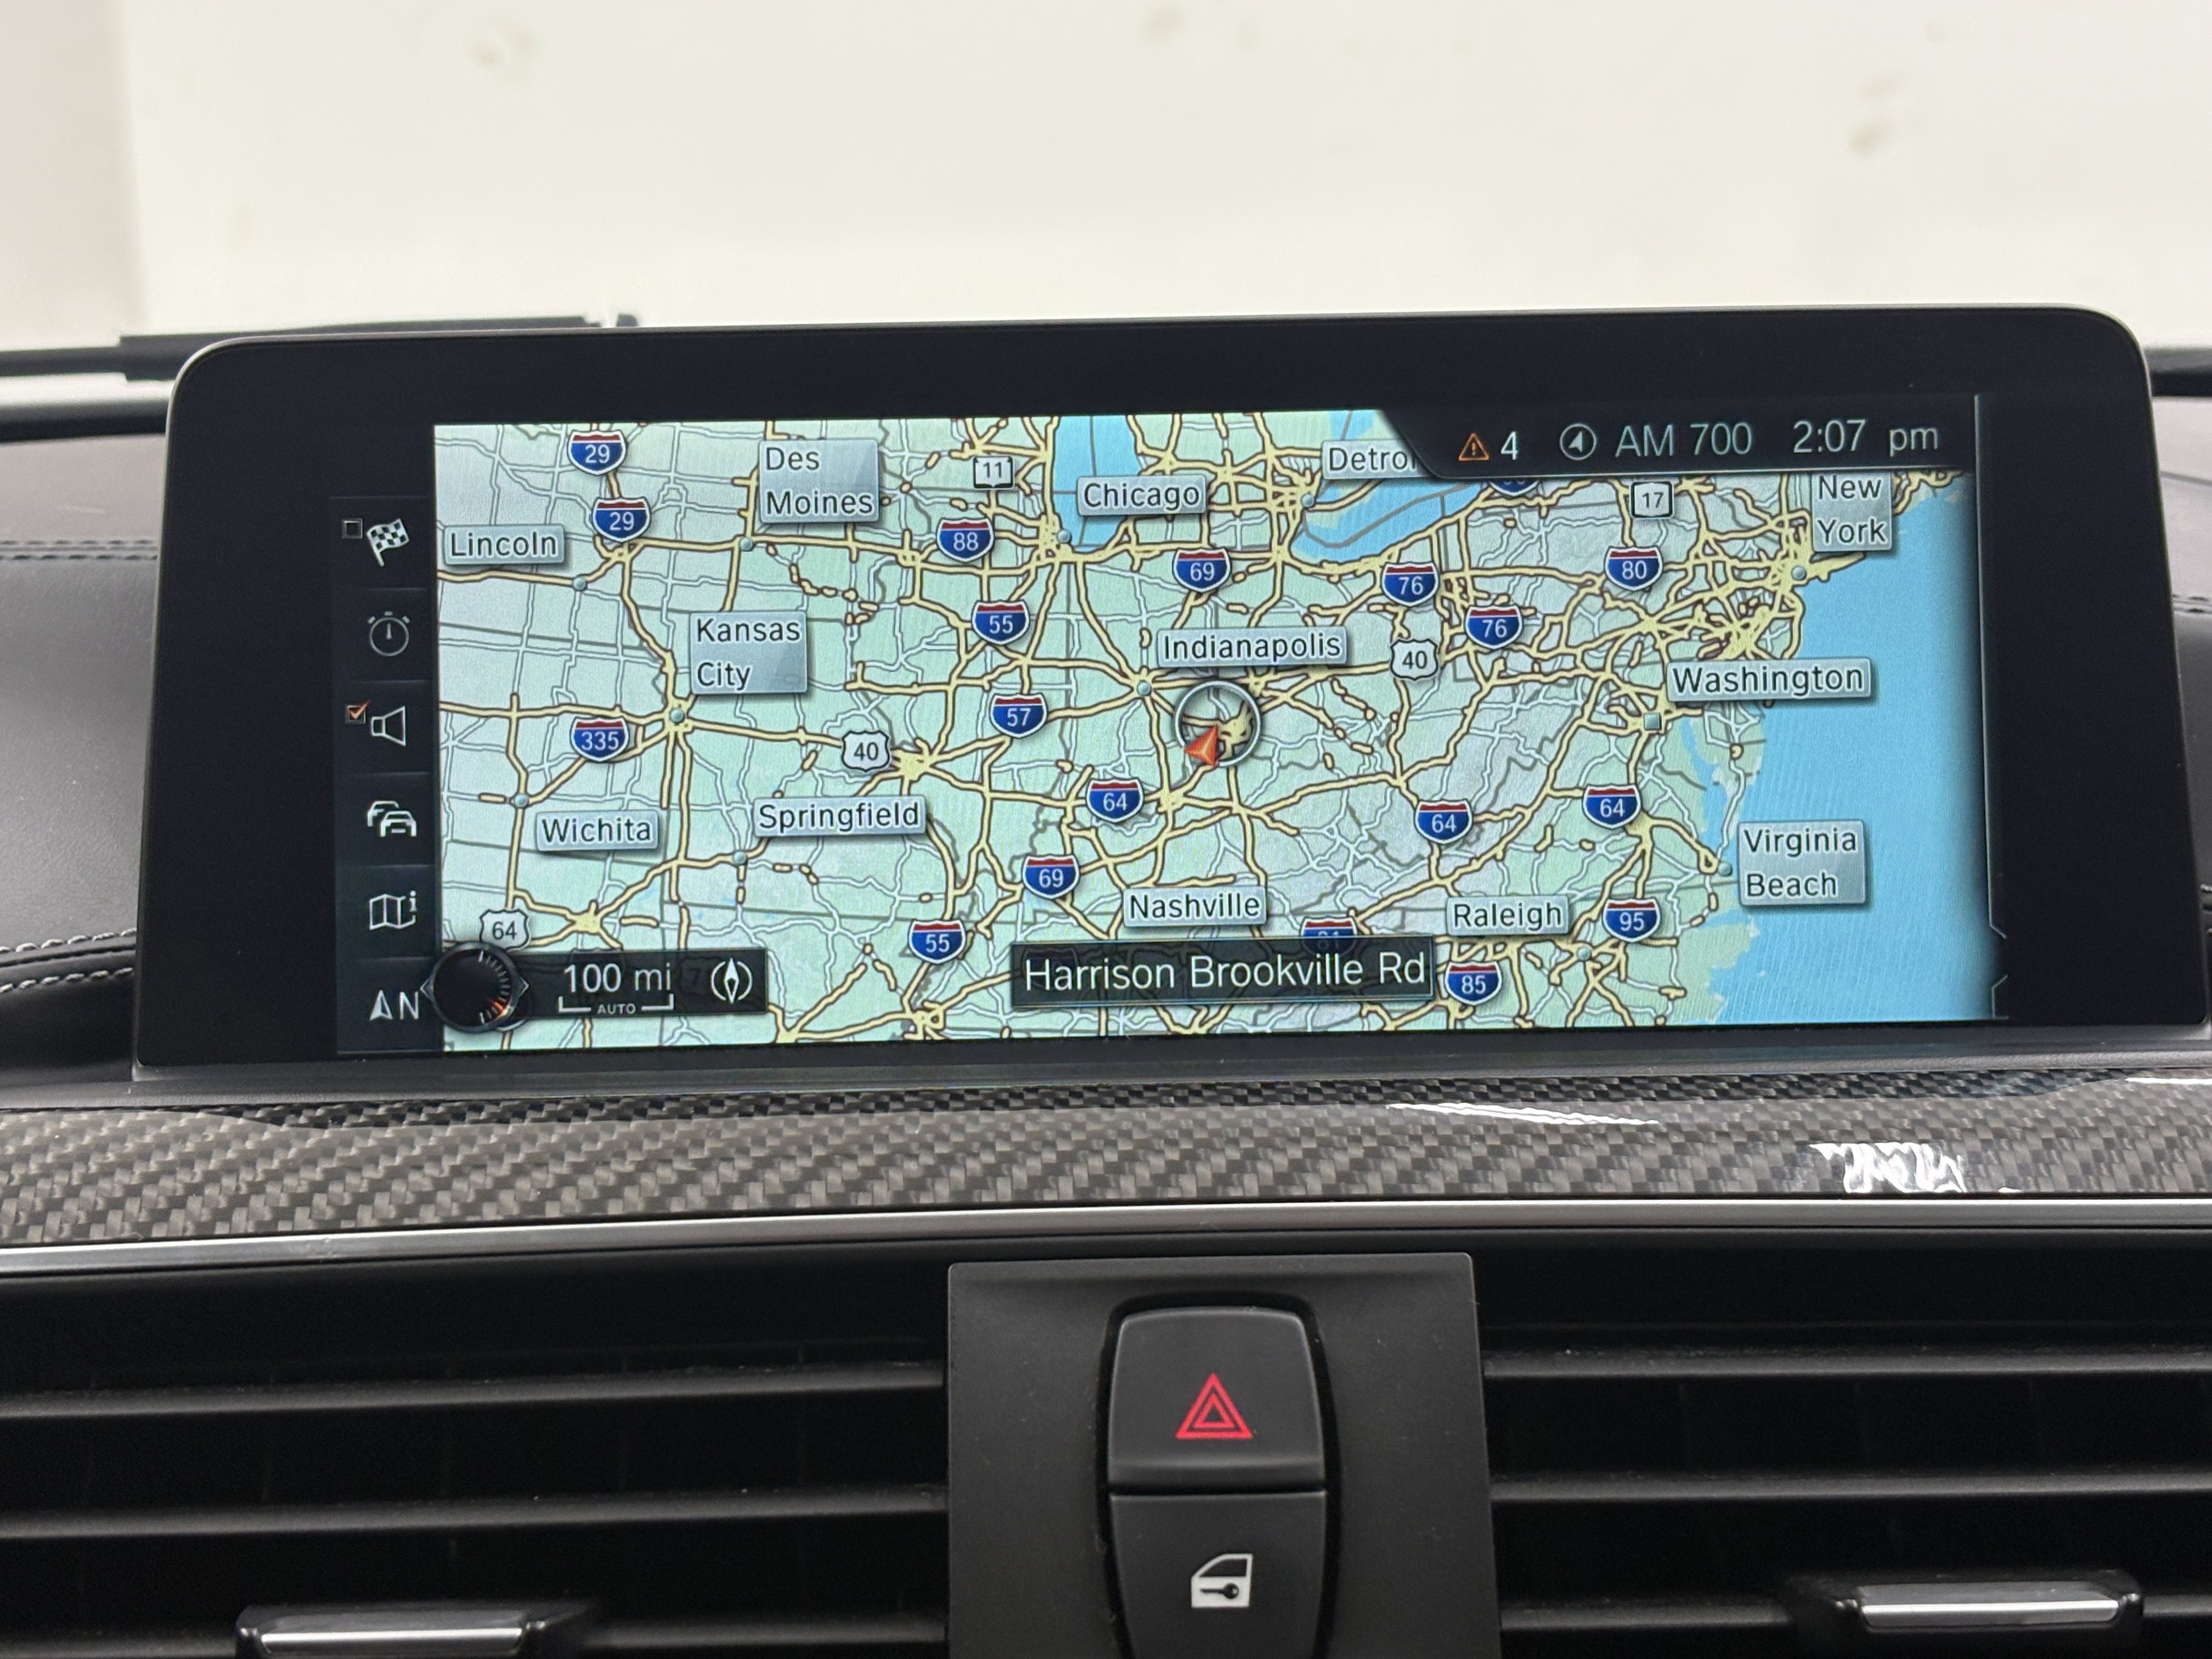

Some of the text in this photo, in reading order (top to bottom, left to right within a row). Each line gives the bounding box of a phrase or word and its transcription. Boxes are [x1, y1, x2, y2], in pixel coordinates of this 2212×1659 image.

[1500, 431, 1518, 460] 4
[1616, 422, 1752, 458] AM 700
[1793, 420, 1938, 456] 2:07 pm
[585, 444, 610, 464] 29
[766, 447, 820, 471] Des
[984, 461, 1002, 478] 11
[1084, 483, 1200, 510] Chicago
[1819, 476, 1882, 500] New
[766, 490, 873, 516] Moines
[1642, 492, 1663, 509] 17
[610, 511, 635, 531] 29
[1817, 518, 1887, 544] York
[450, 532, 557, 557] Lincoln
[953, 532, 978, 551] 88
[1190, 562, 1215, 582] 69
[1622, 560, 1646, 580] 80
[1398, 577, 1423, 596] 76
[696, 619, 800, 642] Kansas
[989, 615, 1013, 634] 55
[1482, 619, 1507, 638] 76
[1164, 631, 1341, 662] Indianapolis
[1402, 651, 1426, 670] 40
[697, 661, 751, 692] City
[1673, 662, 1863, 696] Washington
[1006, 708, 1030, 727] 57
[581, 731, 619, 751] 335
[854, 742, 878, 761] 40
[1103, 792, 1127, 811] 64
[1600, 798, 1625, 817] 64
[759, 801, 919, 833] Springfield
[1432, 812, 1456, 832] 64
[542, 817, 652, 844] Wichita
[1743, 826, 1857, 857] Virginia
[1038, 868, 1063, 888] 69
[1746, 872, 1837, 897] Beach
[1130, 893, 1260, 919] Nashville
[1453, 903, 1562, 930] Raleigh
[1620, 912, 1645, 932] 95
[493, 921, 517, 940] 64
[926, 933, 950, 953] 55
[564, 963, 622, 993] 100
[634, 962, 672, 991] mi
[1026, 951, 1425, 991] Harrison Brookville Rd
[1462, 974, 1486, 994] 85
[399, 991, 419, 1020] N
[597, 1003, 636, 1014] AUTO
